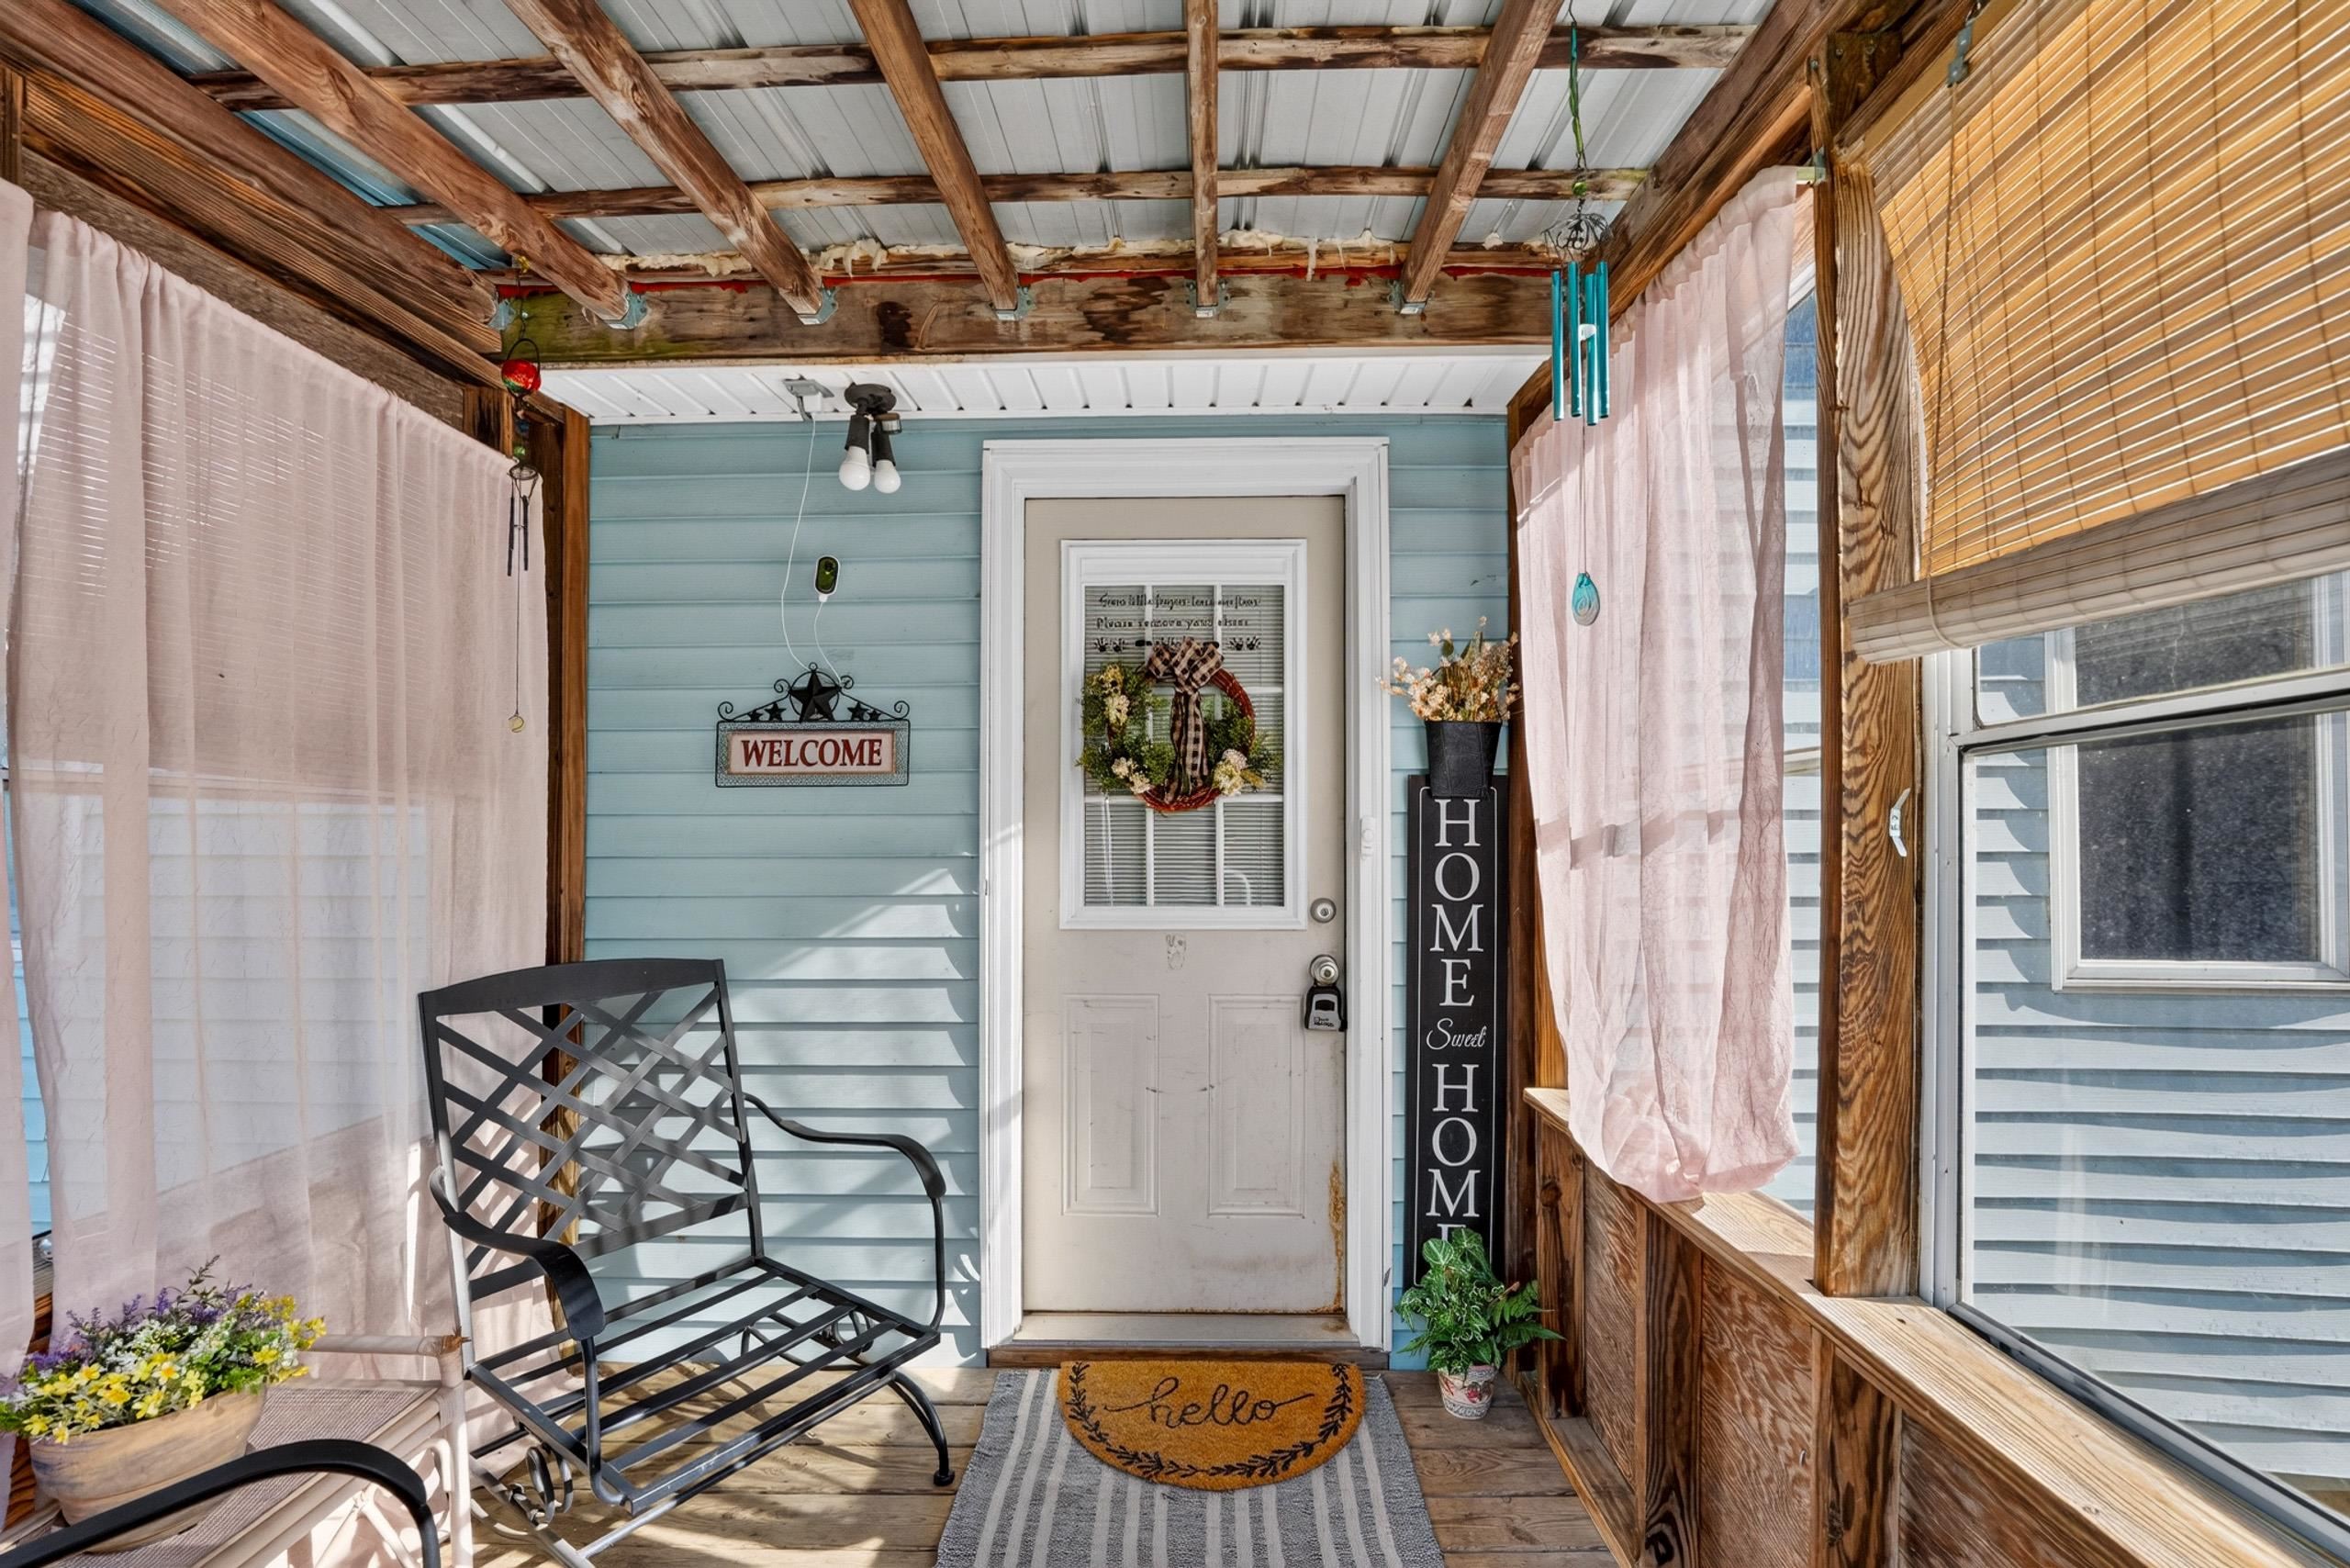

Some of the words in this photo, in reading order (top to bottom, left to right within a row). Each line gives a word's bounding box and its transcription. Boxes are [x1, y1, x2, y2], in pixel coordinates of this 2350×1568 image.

[1096, 617, 1133, 629] Please
[1137, 619, 1182, 628] remove
[1186, 619, 1214, 631] your
[1218, 616, 1248, 628] shoes
[741, 739, 882, 767] WELCOME
[1429, 799, 1483, 1007] HOME
[1426, 1018, 1488, 1050] Sweet
[1104, 1377, 1315, 1428] hello
